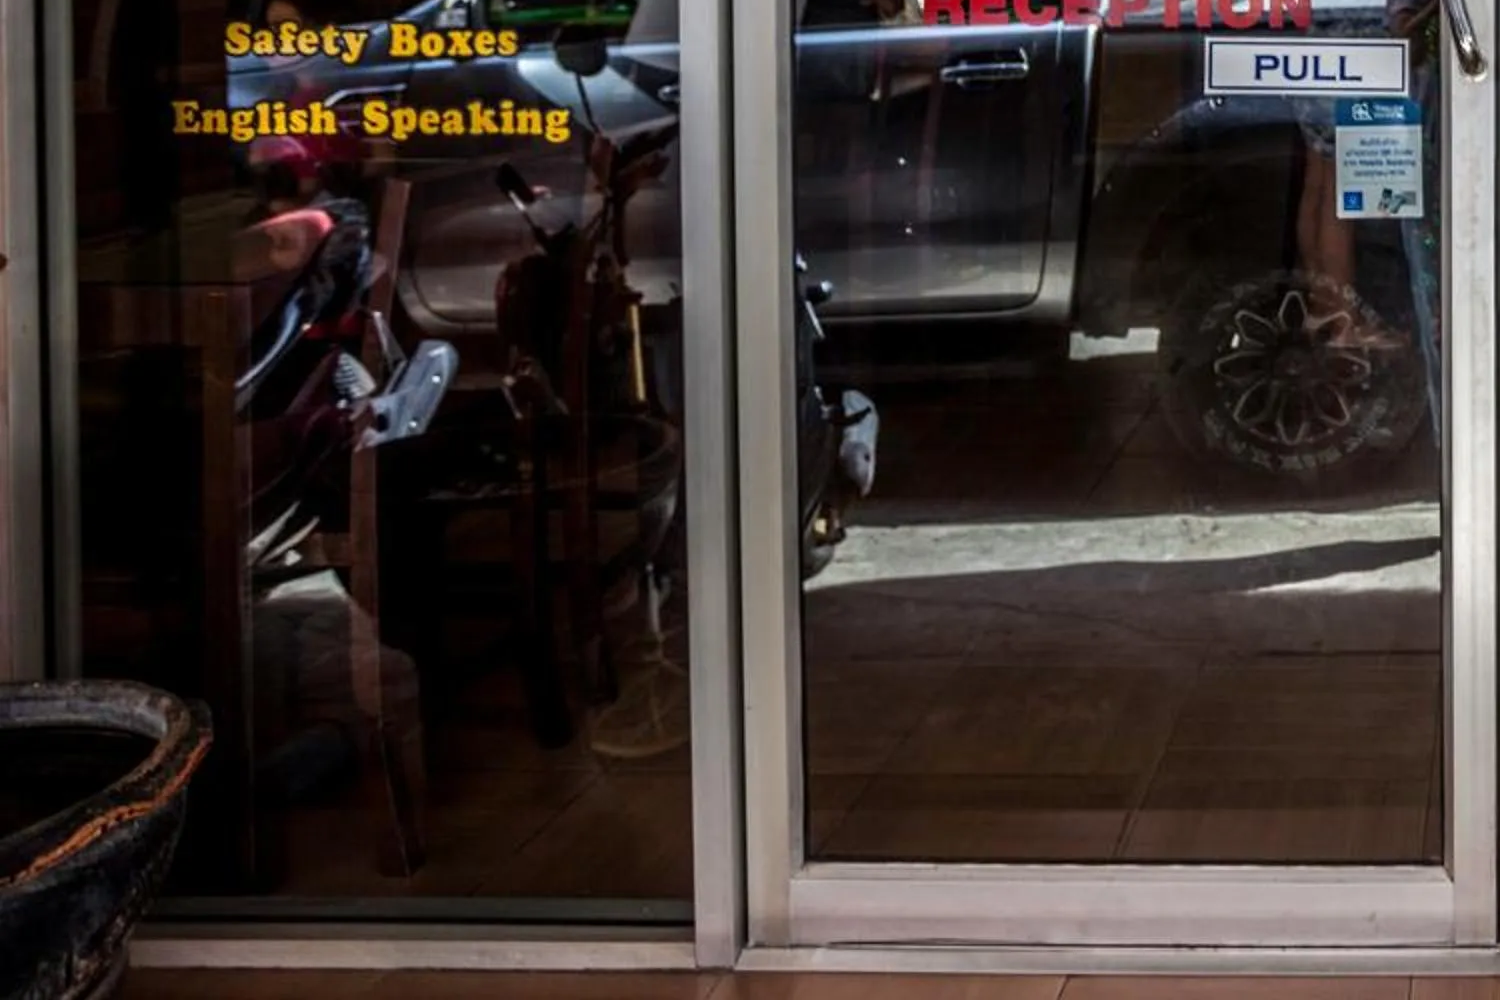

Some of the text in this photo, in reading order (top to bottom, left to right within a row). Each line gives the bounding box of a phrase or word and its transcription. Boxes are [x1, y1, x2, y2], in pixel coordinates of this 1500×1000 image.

[225, 21, 518, 64] Safety Boxes
[1254, 55, 1363, 82] PULL
[171, 99, 571, 142] English Speaking
